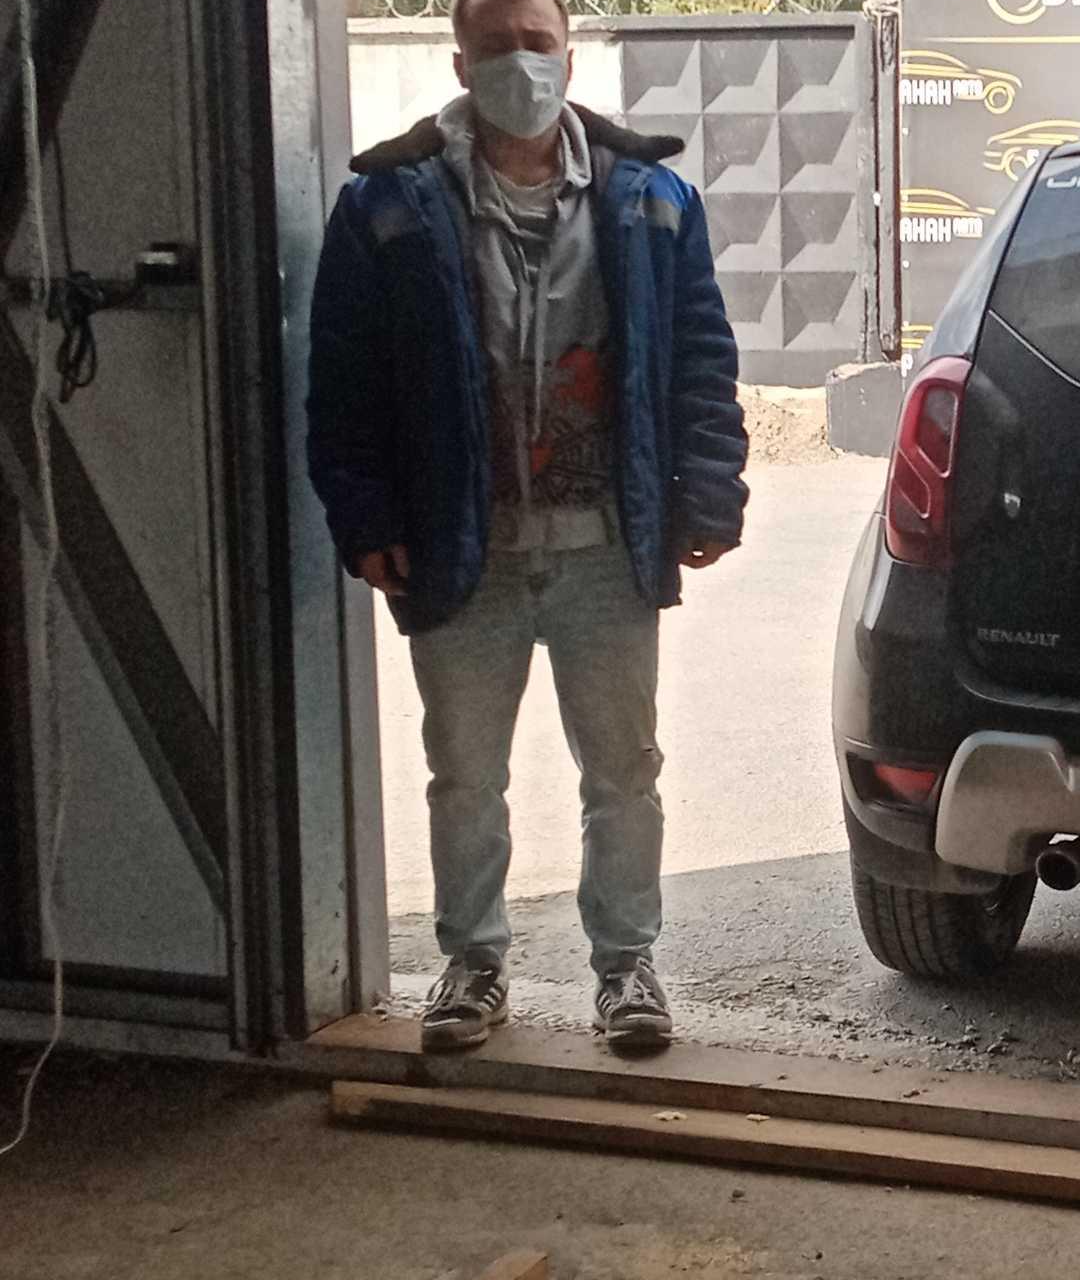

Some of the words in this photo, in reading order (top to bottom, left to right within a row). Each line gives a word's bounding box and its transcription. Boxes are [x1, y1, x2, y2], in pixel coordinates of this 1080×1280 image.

[901, 79, 952, 106] АНАН
[900, 217, 951, 242] АНАН
[977, 628, 1060, 648] RENAULT
